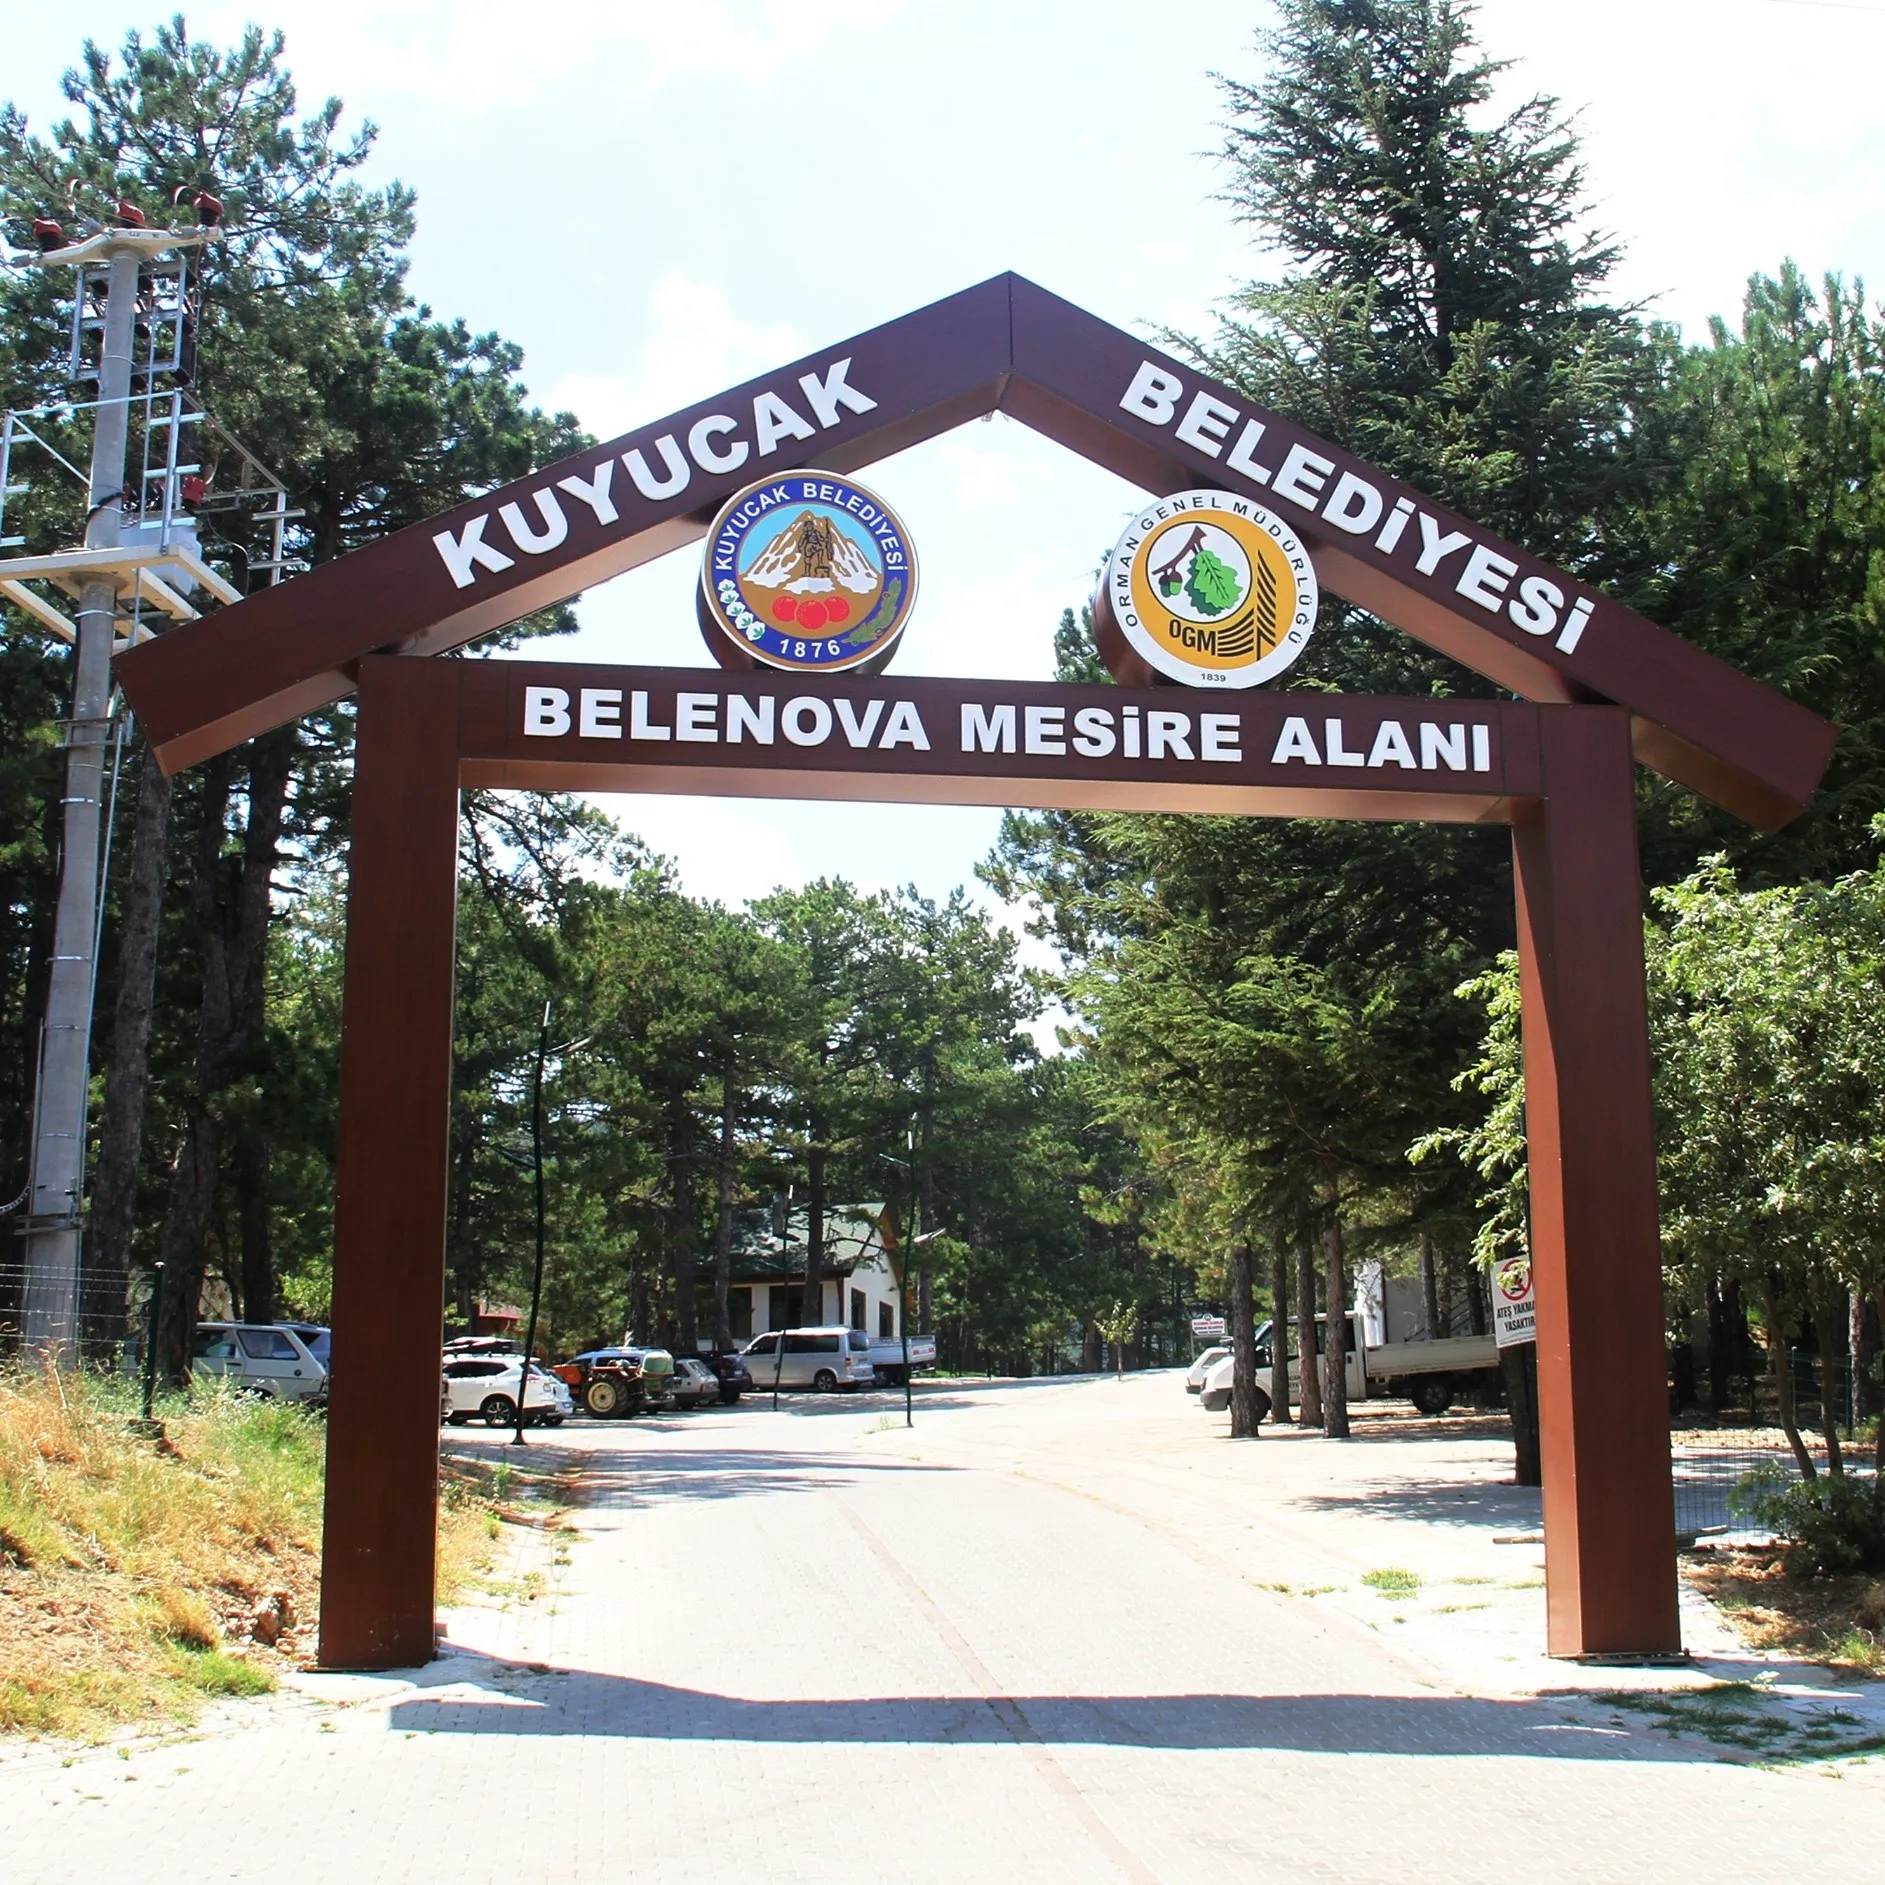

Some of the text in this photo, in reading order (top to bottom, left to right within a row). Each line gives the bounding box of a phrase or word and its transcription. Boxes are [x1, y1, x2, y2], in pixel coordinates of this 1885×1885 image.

[433, 357, 878, 589] KUYUCAK
[1119, 360, 1595, 655] BELEDİYESİ
[716, 483, 908, 571] KUYUCAK BELEDİYESİ
[1117, 497, 1313, 645] ORMAN GENEL MÜDÜRLÜĞÜ
[780, 639, 840, 658] 1876
[1169, 619, 1216, 656] OGM
[1201, 673, 1226, 682] 1839
[524, 686, 1490, 772] BELENOVA MESİRE ALANI
[1497, 1306, 1512, 1319] ATEŞ
